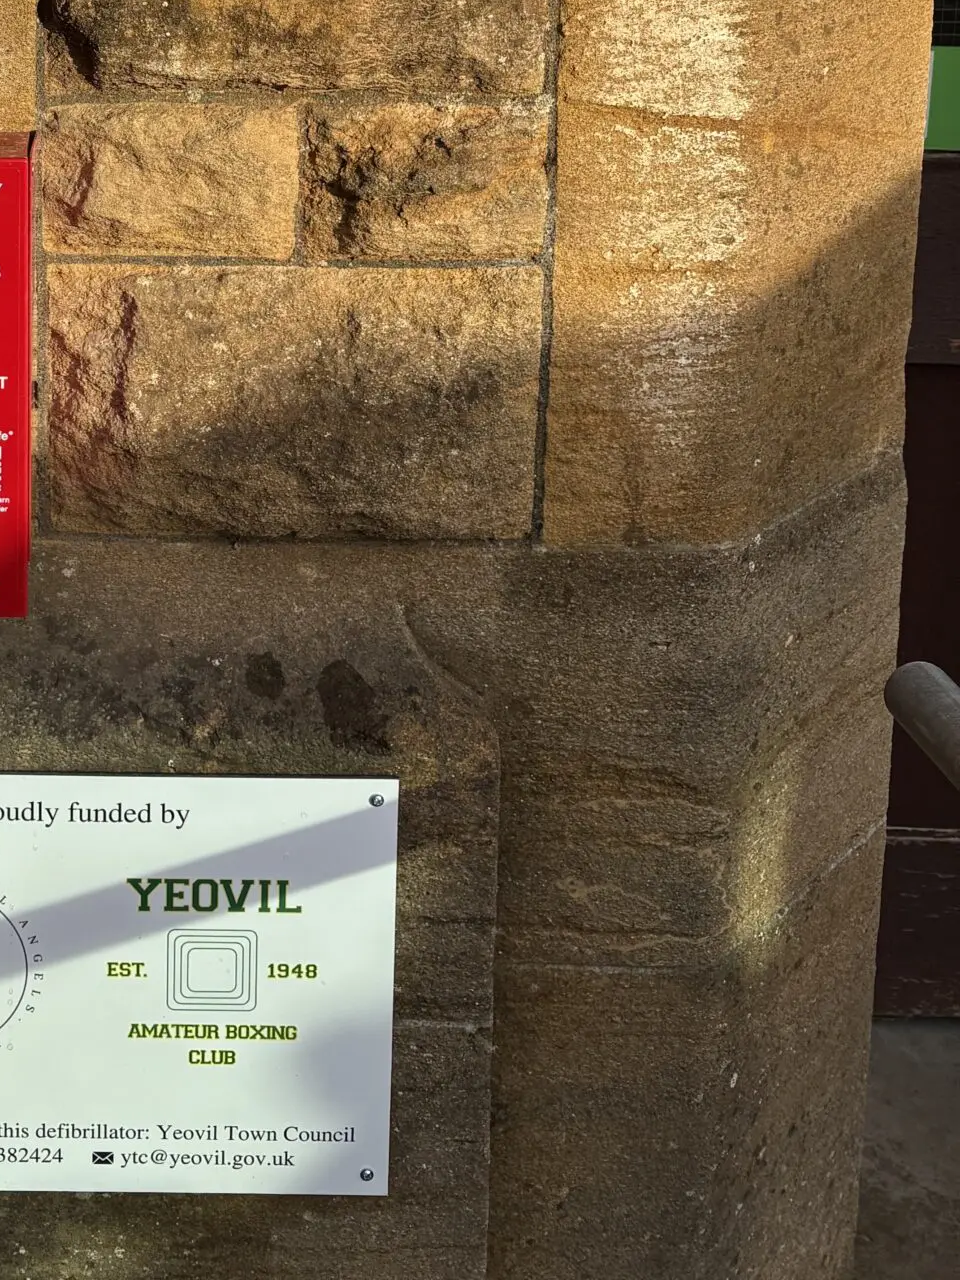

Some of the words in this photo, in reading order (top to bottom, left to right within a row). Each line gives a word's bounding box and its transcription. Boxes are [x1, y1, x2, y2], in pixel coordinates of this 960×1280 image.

[70, 802, 151, 823] funded
[161, 804, 189, 829] by
[127, 877, 303, 913] YEOVIL
[107, 962, 147, 977] EST.
[268, 964, 317, 978] 1948
[128, 1024, 219, 1039] AMATEUR
[226, 1025, 297, 1040] BOXING
[189, 1050, 235, 1064] CLUB
[36, 1123, 149, 1139] defibrillator:
[157, 1125, 217, 1140] Yeovil
[225, 1126, 276, 1141] Town
[284, 1127, 354, 1142] Council
[121, 1150, 294, 1169] ytc@yeovil.gov.uk
